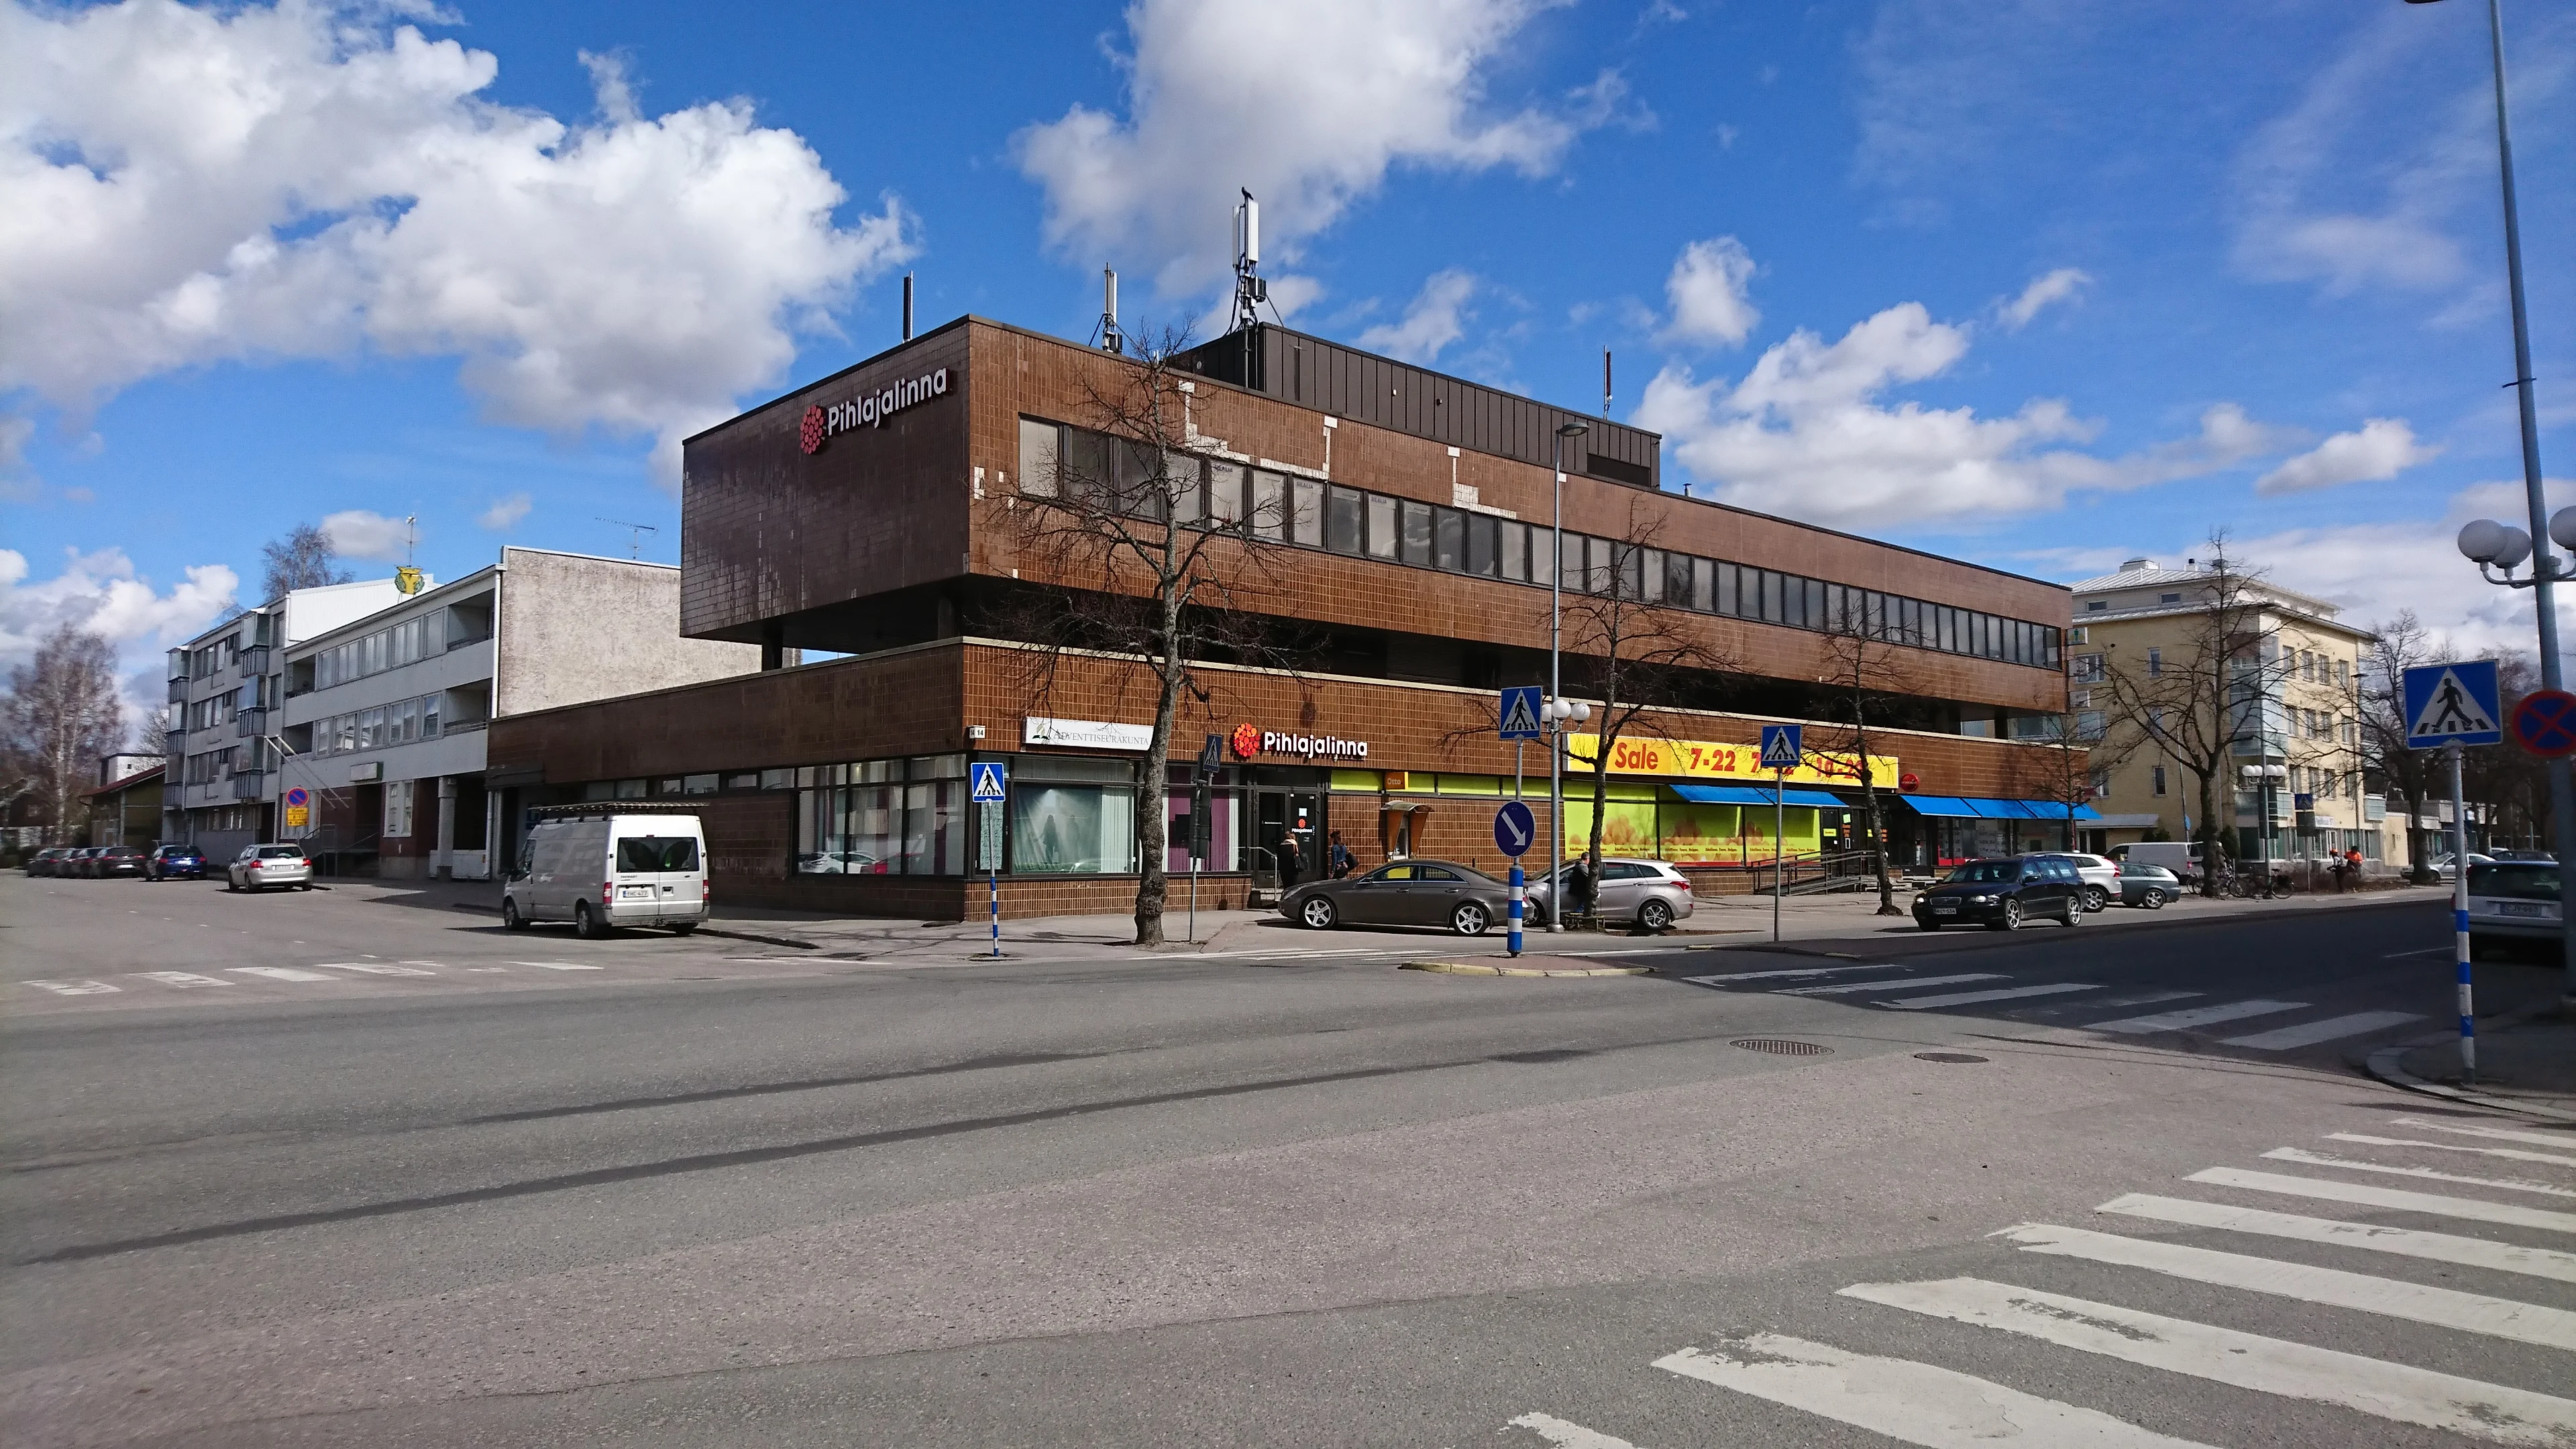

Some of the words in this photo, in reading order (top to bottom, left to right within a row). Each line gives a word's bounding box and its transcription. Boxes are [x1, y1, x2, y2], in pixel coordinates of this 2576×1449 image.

[827, 368, 947, 436] Pihlajalinna
[1264, 731, 1367, 759] Pihlajalinna
[1615, 742, 1658, 769] Sale
[1690, 747, 1736, 772] 7-22
